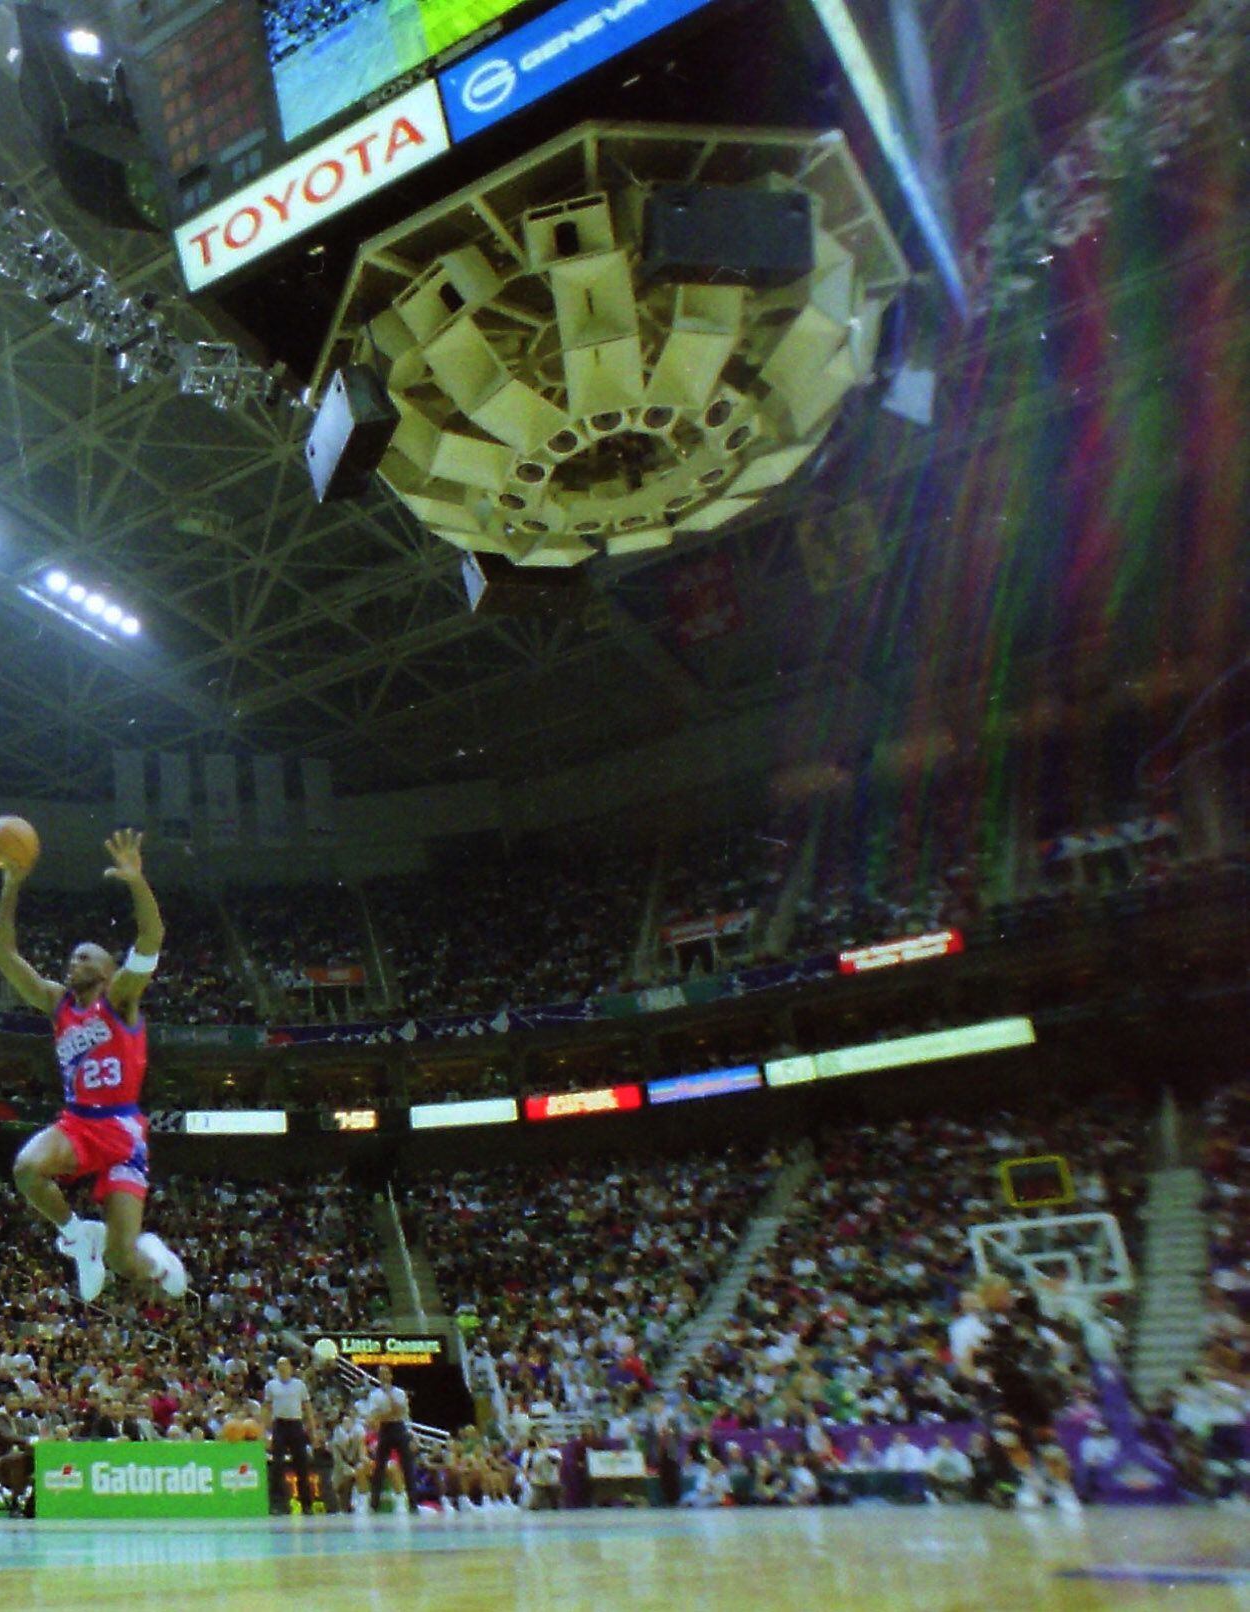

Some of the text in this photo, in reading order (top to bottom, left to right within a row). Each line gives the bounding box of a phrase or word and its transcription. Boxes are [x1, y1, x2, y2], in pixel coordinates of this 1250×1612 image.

[189, 116, 427, 266] TOYOTA
[83, 1056, 122, 1089] 23
[91, 1461, 213, 1495] Gatorade
